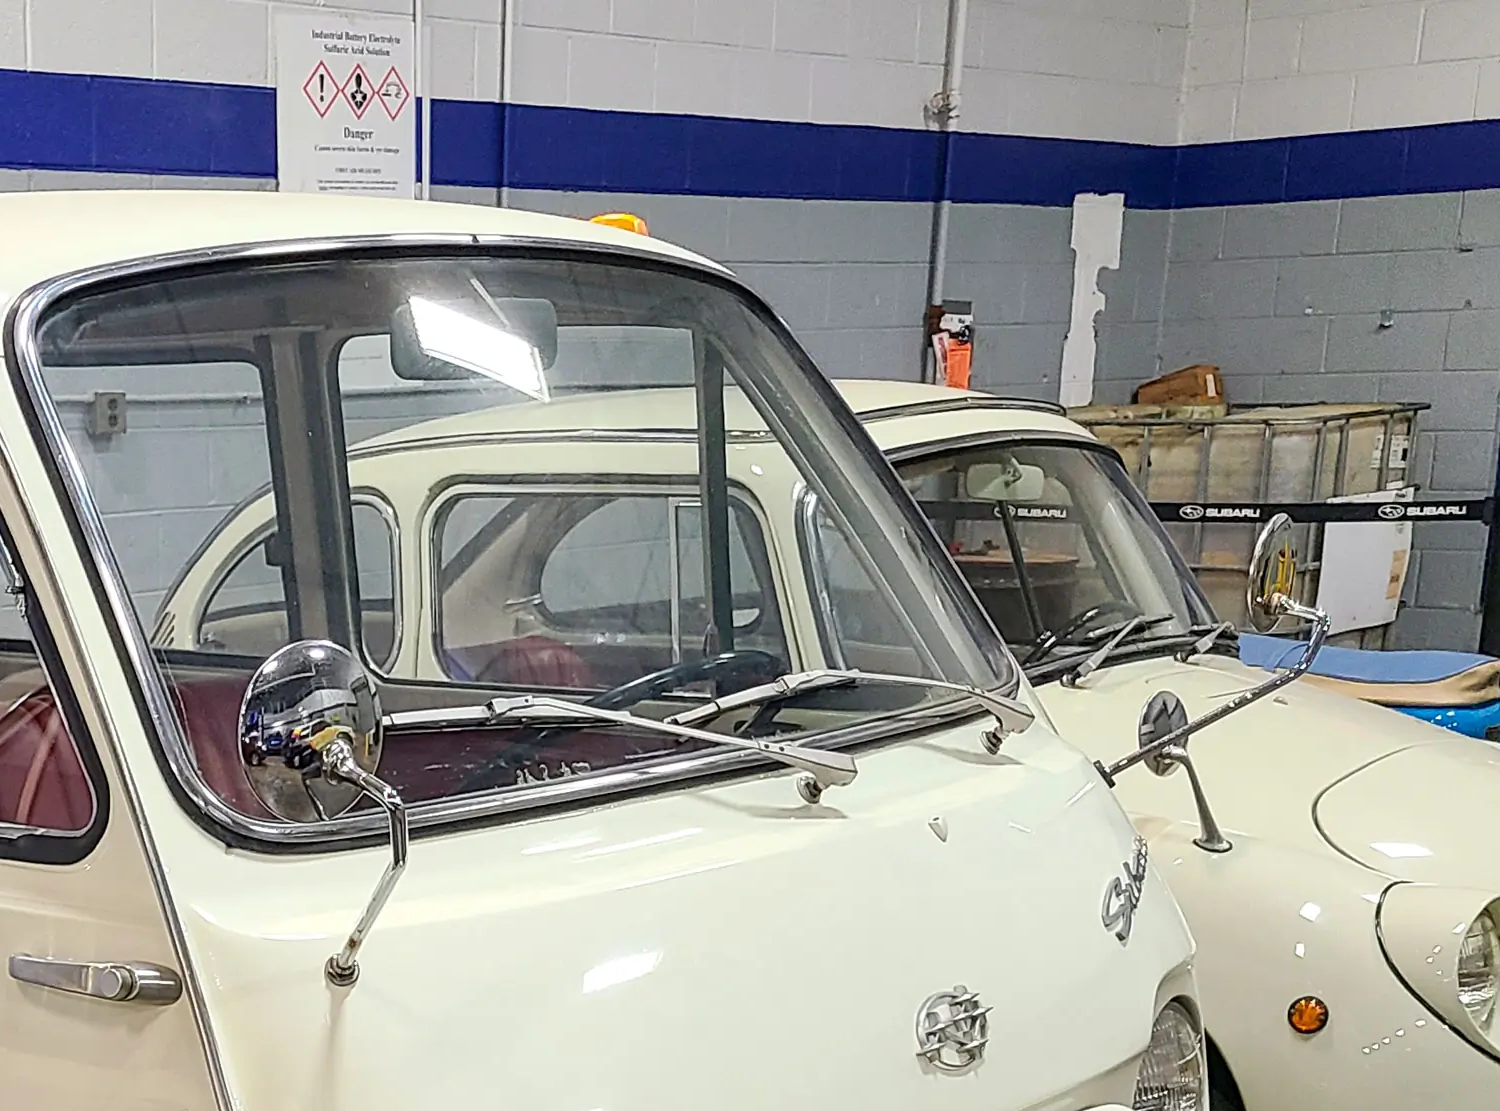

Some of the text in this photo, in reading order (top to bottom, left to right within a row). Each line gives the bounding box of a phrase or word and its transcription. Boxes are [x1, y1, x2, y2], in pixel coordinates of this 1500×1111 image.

[311, 29, 401, 45] Industrial Battery Electrolyte
[351, 46, 364, 55] Acid
[343, 127, 374, 140] Danger
[1017, 507, 1068, 518] SUBARU
[1205, 507, 1261, 518] SUBARU
[1406, 505, 1468, 517] SUBARU
